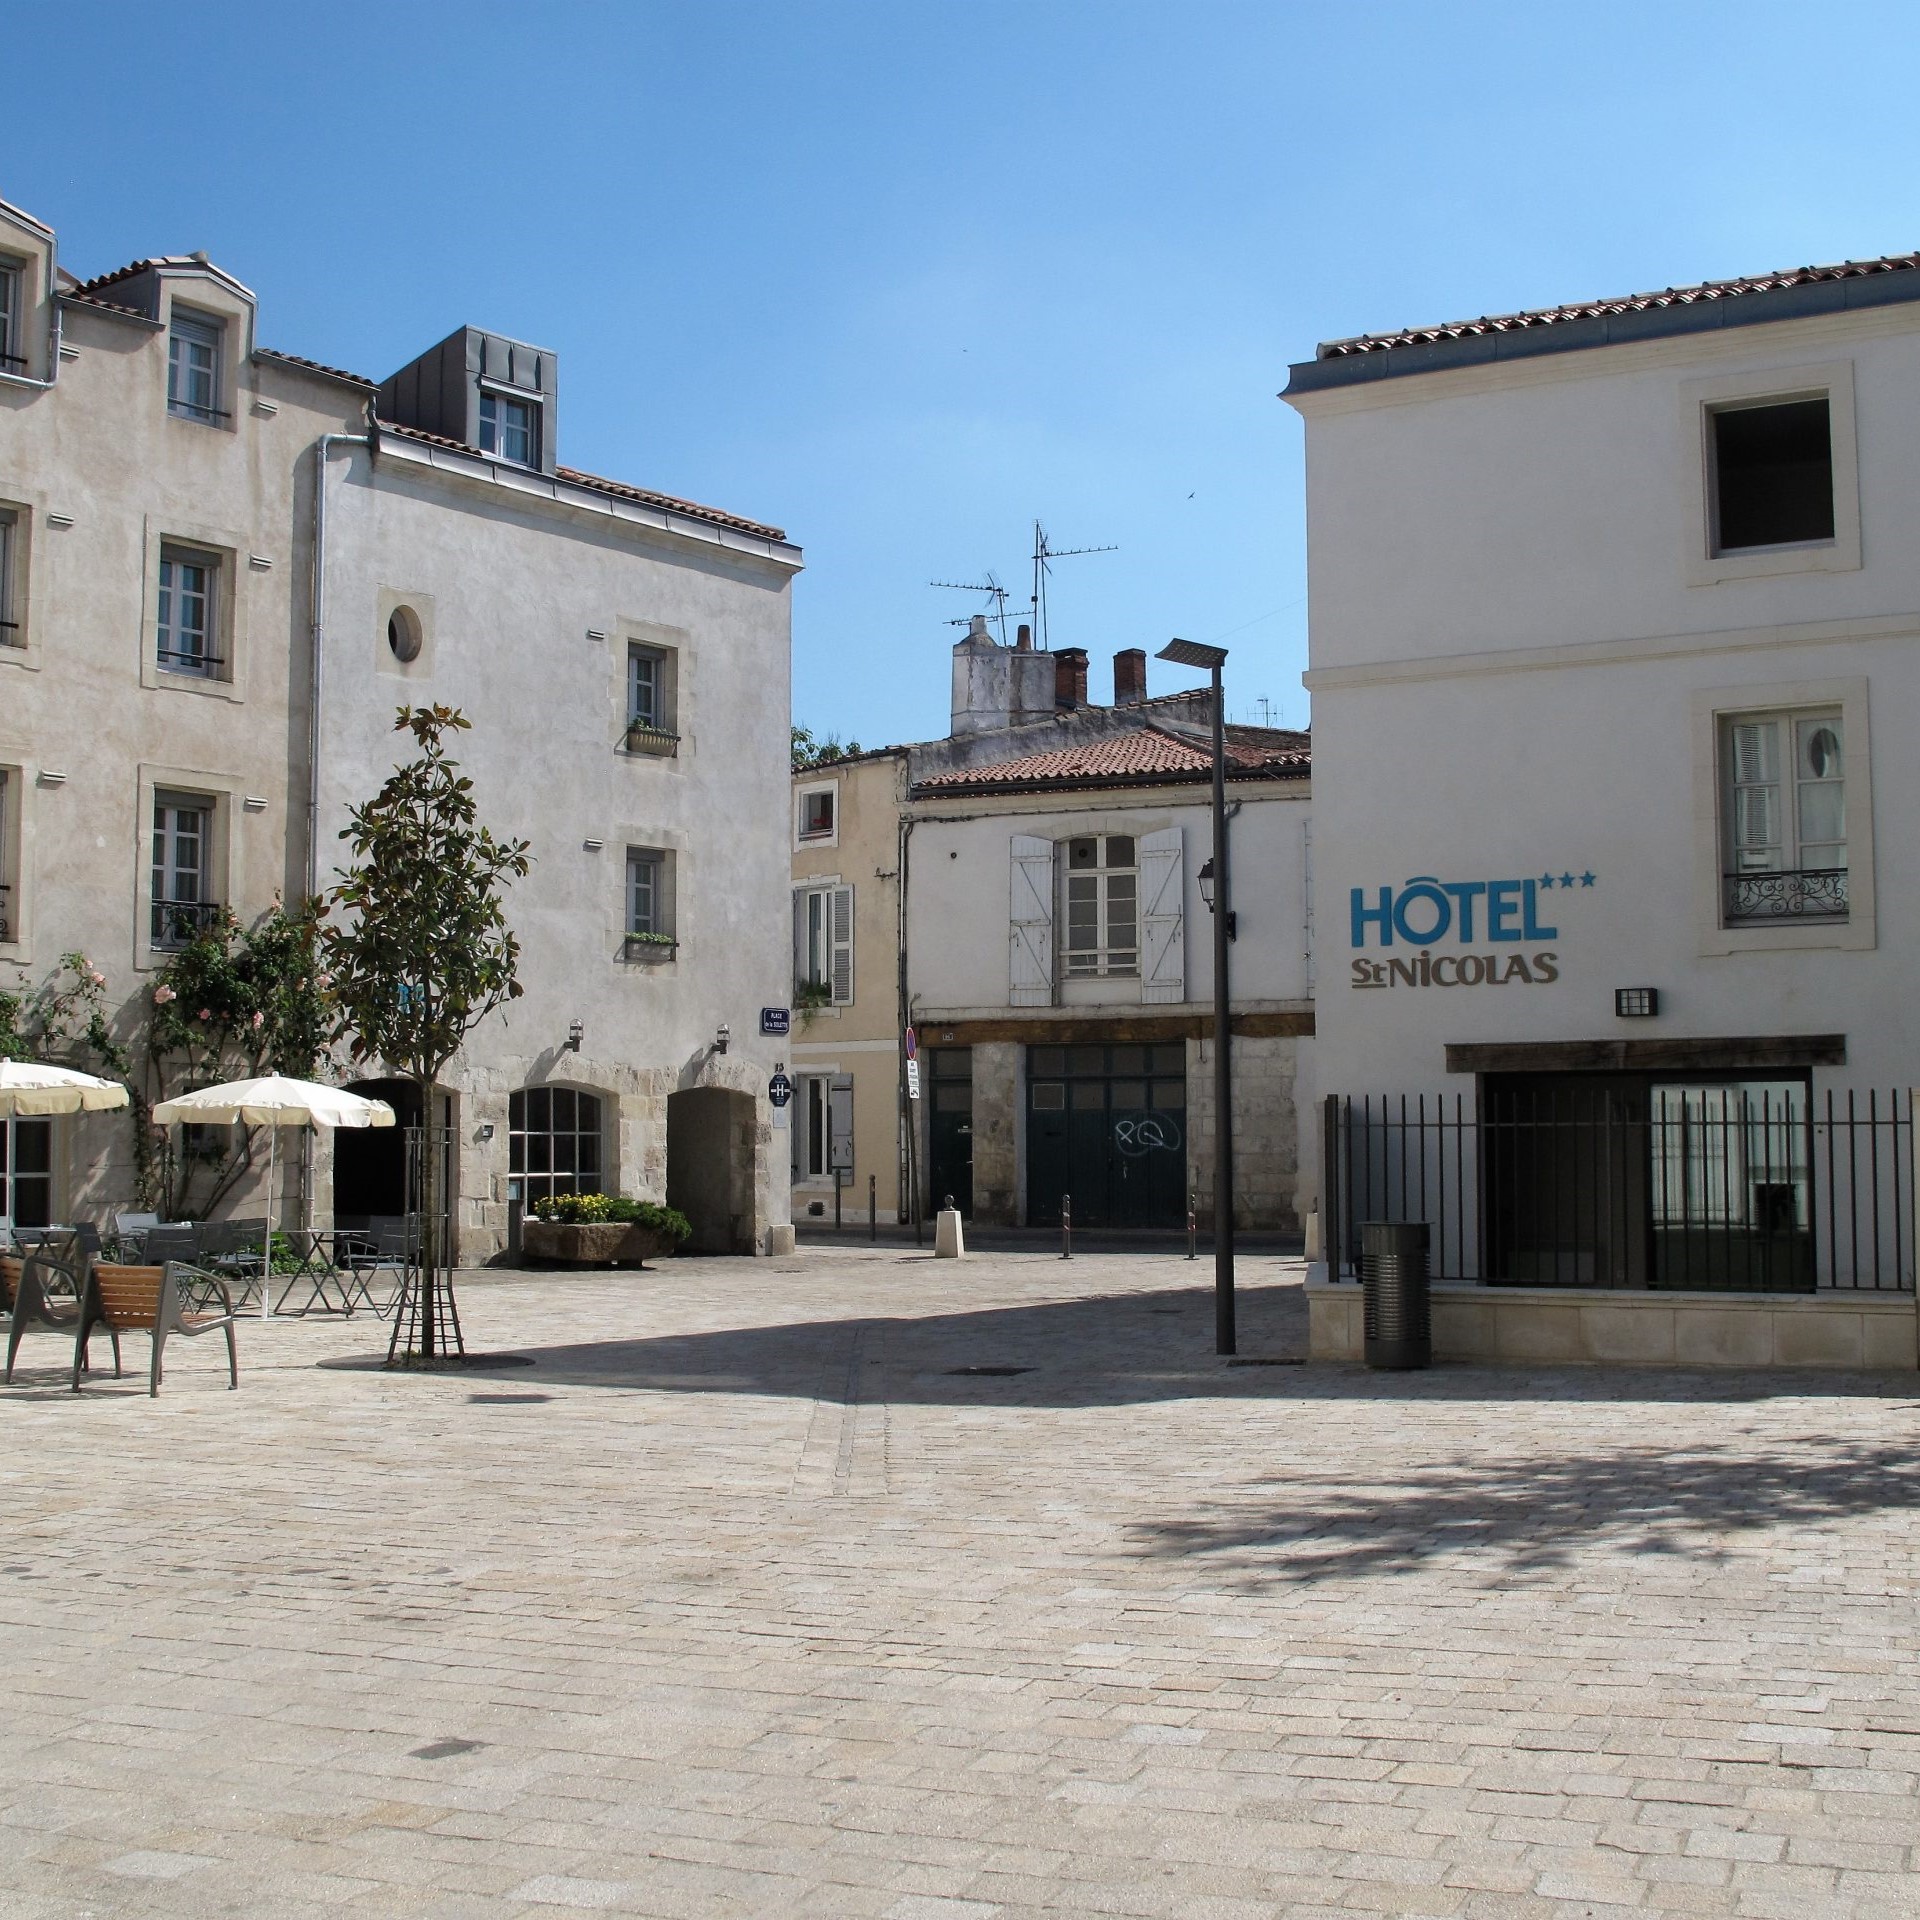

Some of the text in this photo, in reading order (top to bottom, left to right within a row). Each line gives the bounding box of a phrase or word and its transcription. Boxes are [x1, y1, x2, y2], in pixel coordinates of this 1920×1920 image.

[1350, 876, 1557, 947] HÔTEL
[770, 1012, 783, 1020] PLACE
[776, 1084, 784, 1096] H
